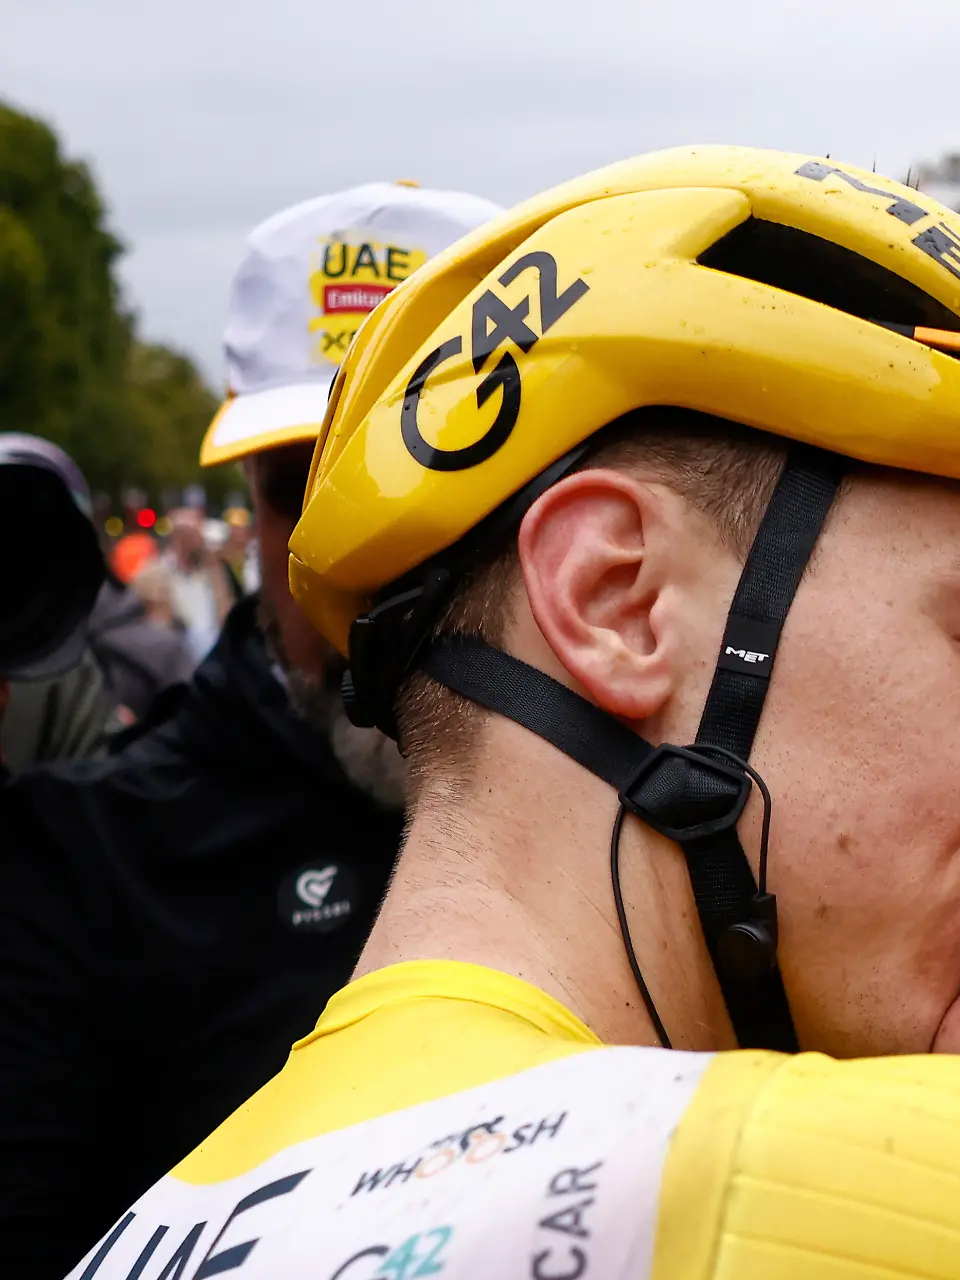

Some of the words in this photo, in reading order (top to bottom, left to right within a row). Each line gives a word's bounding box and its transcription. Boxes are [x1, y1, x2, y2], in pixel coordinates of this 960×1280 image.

[322, 243, 410, 281] UAE
[401, 251, 590, 471] G42
[725, 646, 769, 663] MET
[350, 1110, 569, 1197] WHOOSH
